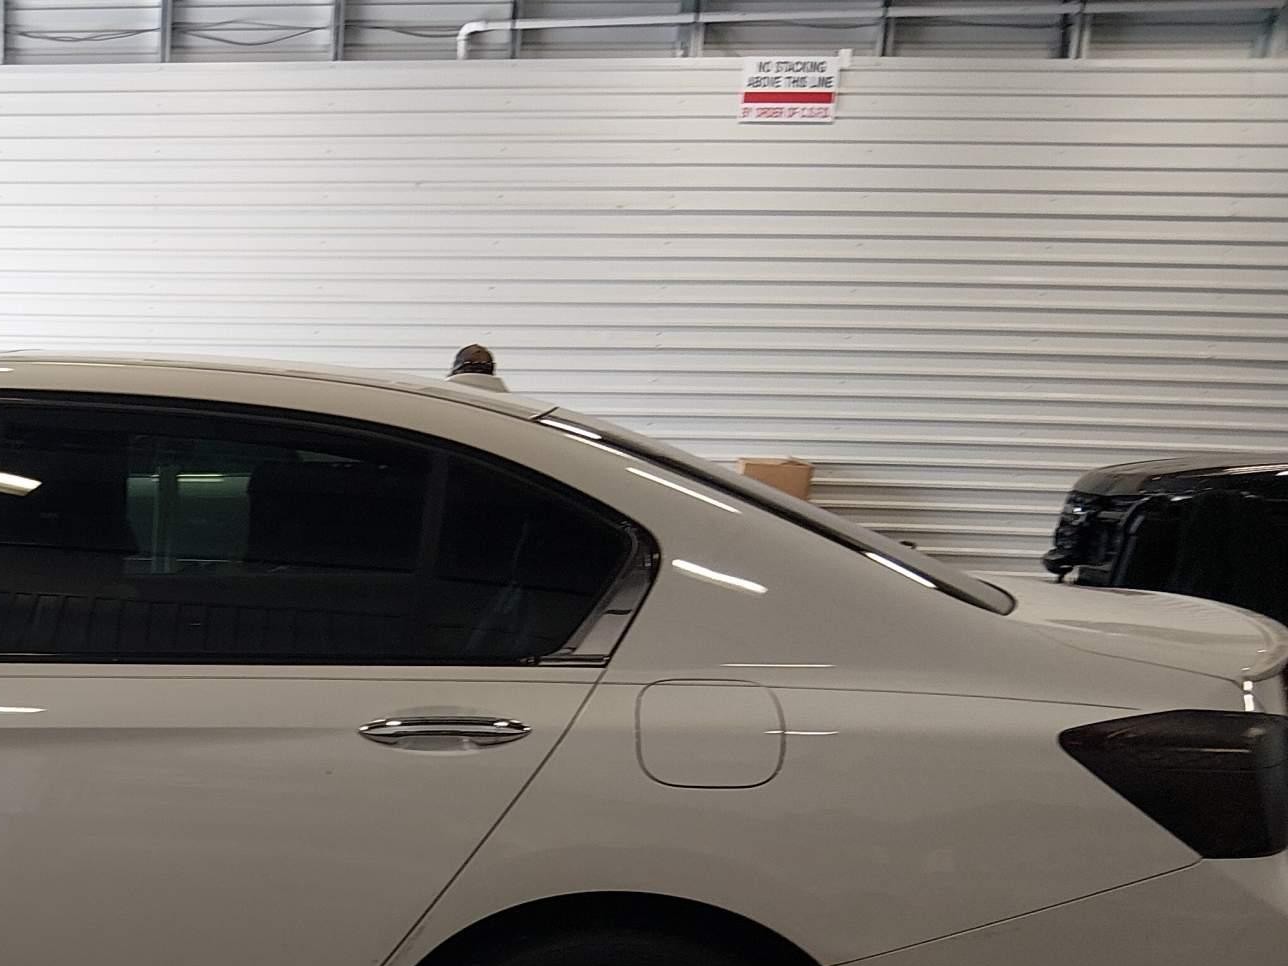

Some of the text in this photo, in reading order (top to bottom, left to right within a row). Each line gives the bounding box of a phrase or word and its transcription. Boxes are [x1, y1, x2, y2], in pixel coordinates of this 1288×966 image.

[774, 61, 827, 73] STACKING
[784, 76, 807, 88] THIS
[810, 76, 834, 88] LINE
